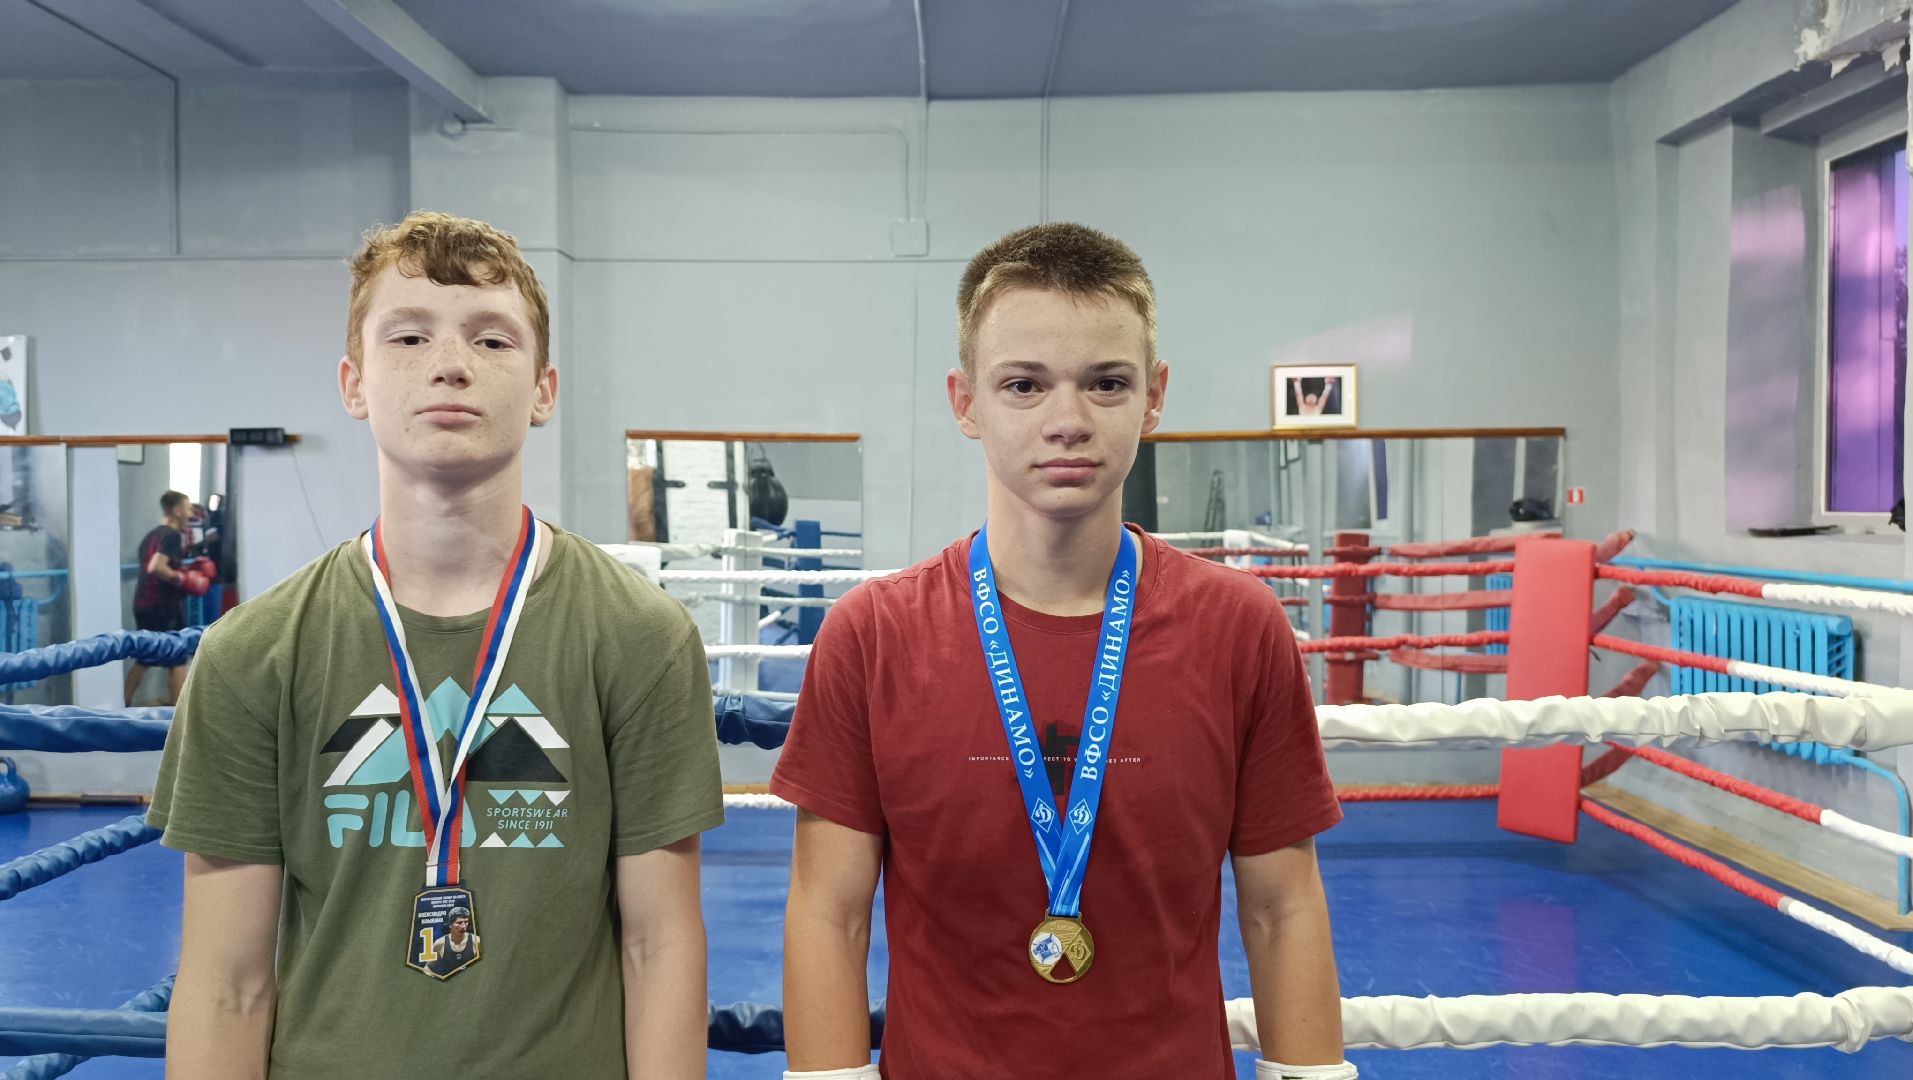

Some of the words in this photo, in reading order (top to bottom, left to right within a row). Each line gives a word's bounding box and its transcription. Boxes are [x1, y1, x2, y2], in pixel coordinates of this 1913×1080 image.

[973, 567, 999, 635] ВФСО
[986, 640, 1036, 779] «ДИНАМО»
[1080, 706, 1109, 781] ВФСО
[1098, 569, 1131, 701] «ДИНАМО»
[486, 807, 568, 818] SPORTSWEAR
[497, 819, 531, 830] SINCE
[534, 820, 554, 830] 1911
[418, 926, 438, 963] 1
